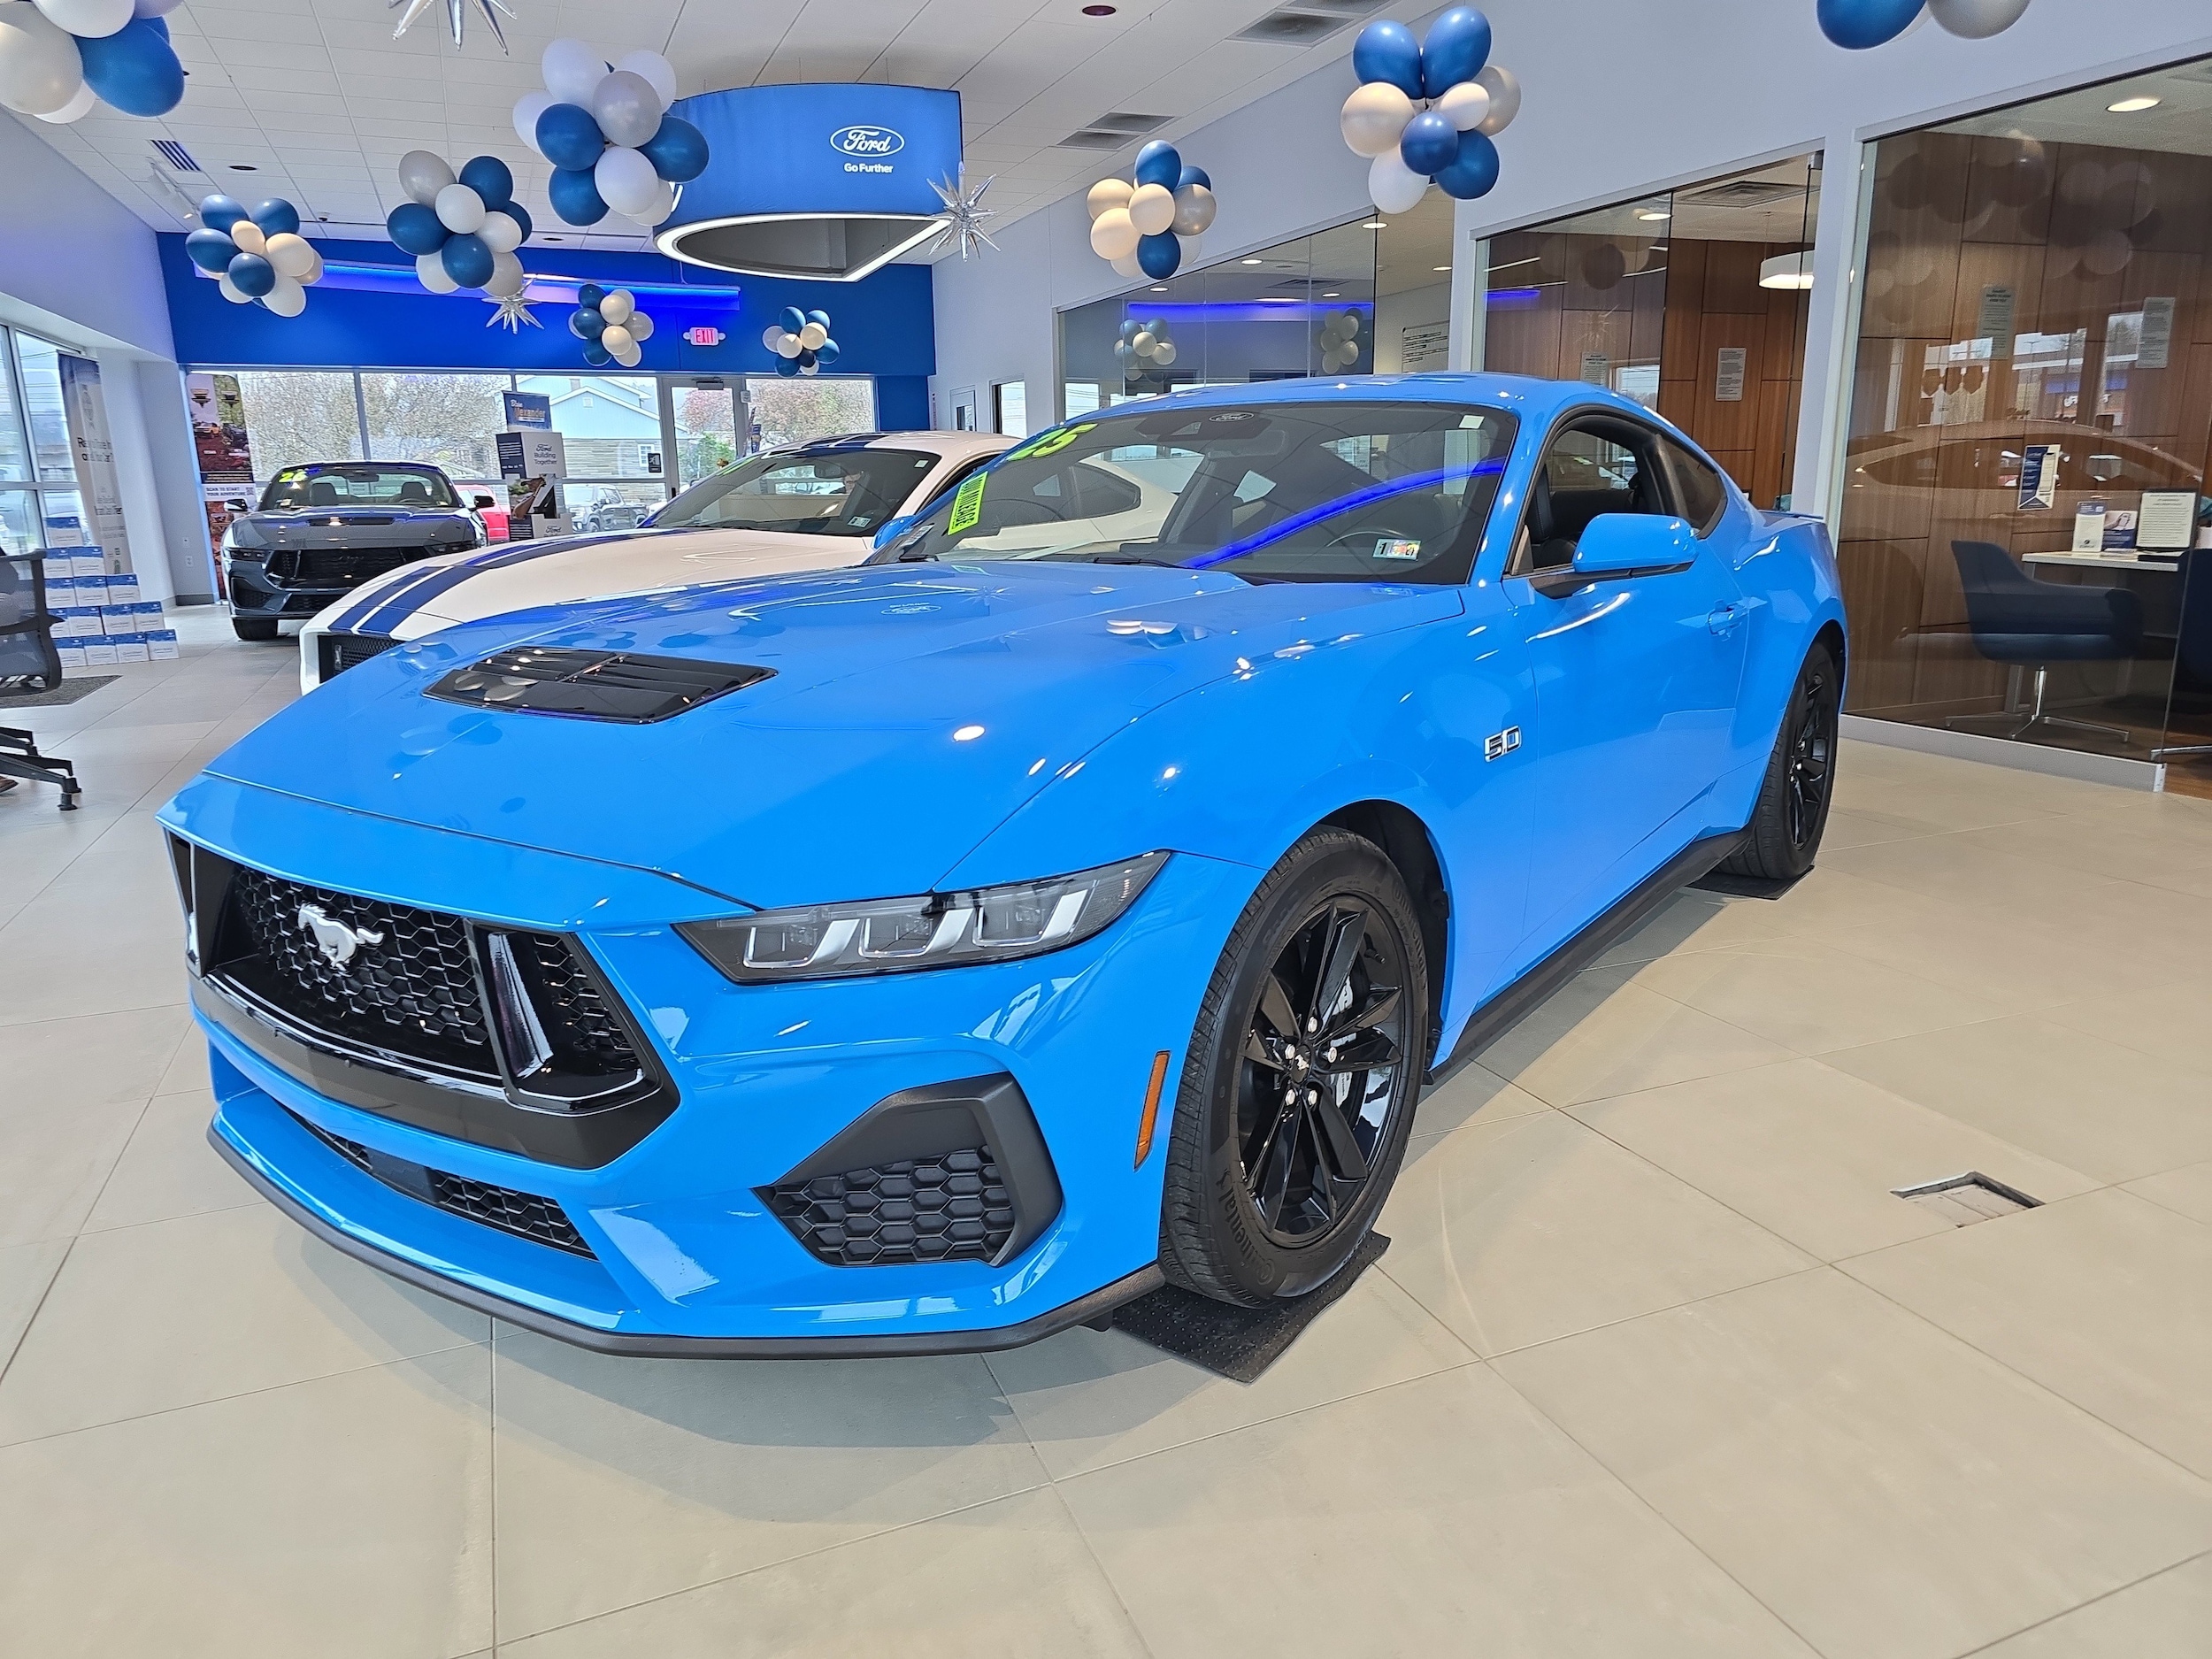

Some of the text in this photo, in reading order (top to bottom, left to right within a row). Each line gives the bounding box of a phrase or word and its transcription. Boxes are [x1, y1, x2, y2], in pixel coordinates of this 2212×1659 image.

[843, 129, 892, 152] Ford
[844, 163, 894, 173] Go Further
[695, 328, 714, 343] EXIT
[536, 443, 553, 452] Ford
